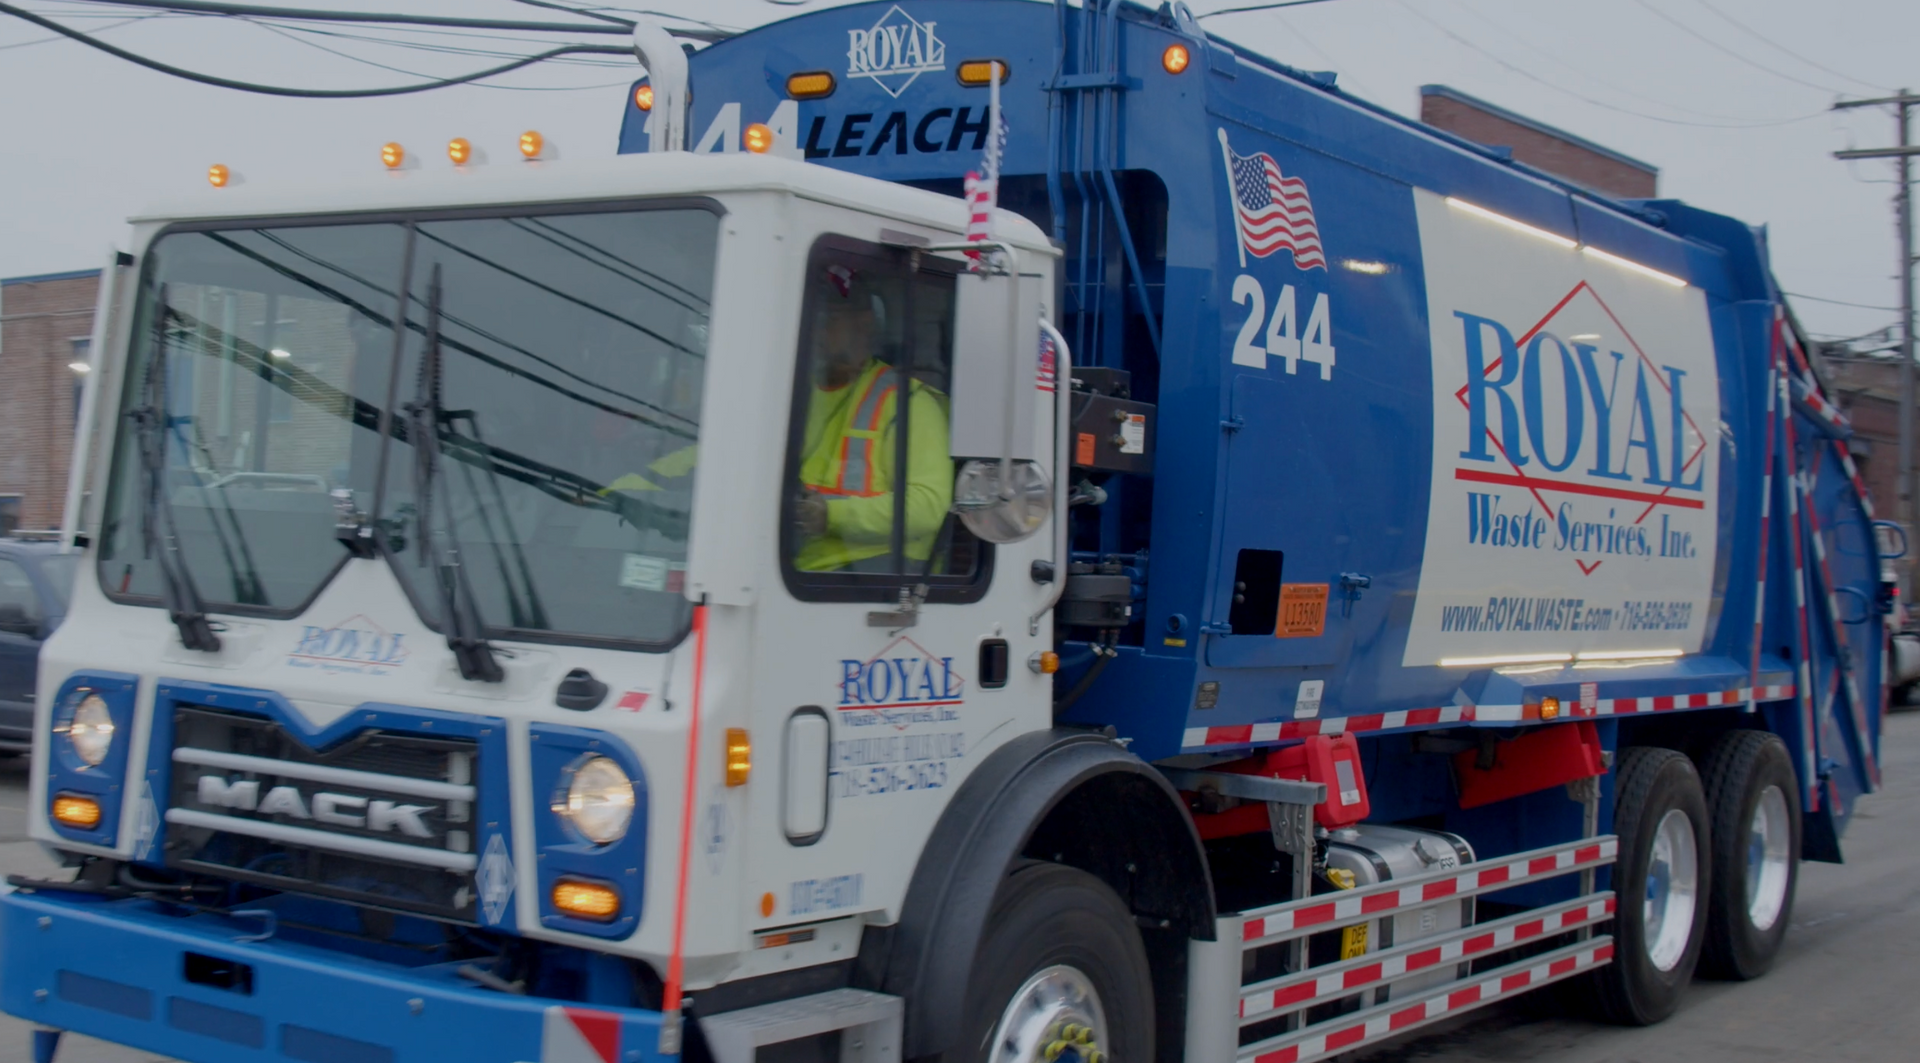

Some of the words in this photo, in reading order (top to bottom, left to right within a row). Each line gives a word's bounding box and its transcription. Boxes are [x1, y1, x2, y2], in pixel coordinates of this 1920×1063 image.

[847, 21, 945, 72] ROYAL
[804, 105, 993, 159] LEACH
[1231, 274, 1336, 381] 244
[1453, 310, 1704, 492] ROYAL
[1466, 491, 1547, 550] Waste
[1554, 501, 1651, 561] Services,
[1659, 513, 1697, 559] Inc.
[840, 657, 963, 705] ROYAL
[197, 774, 437, 838] MACK
